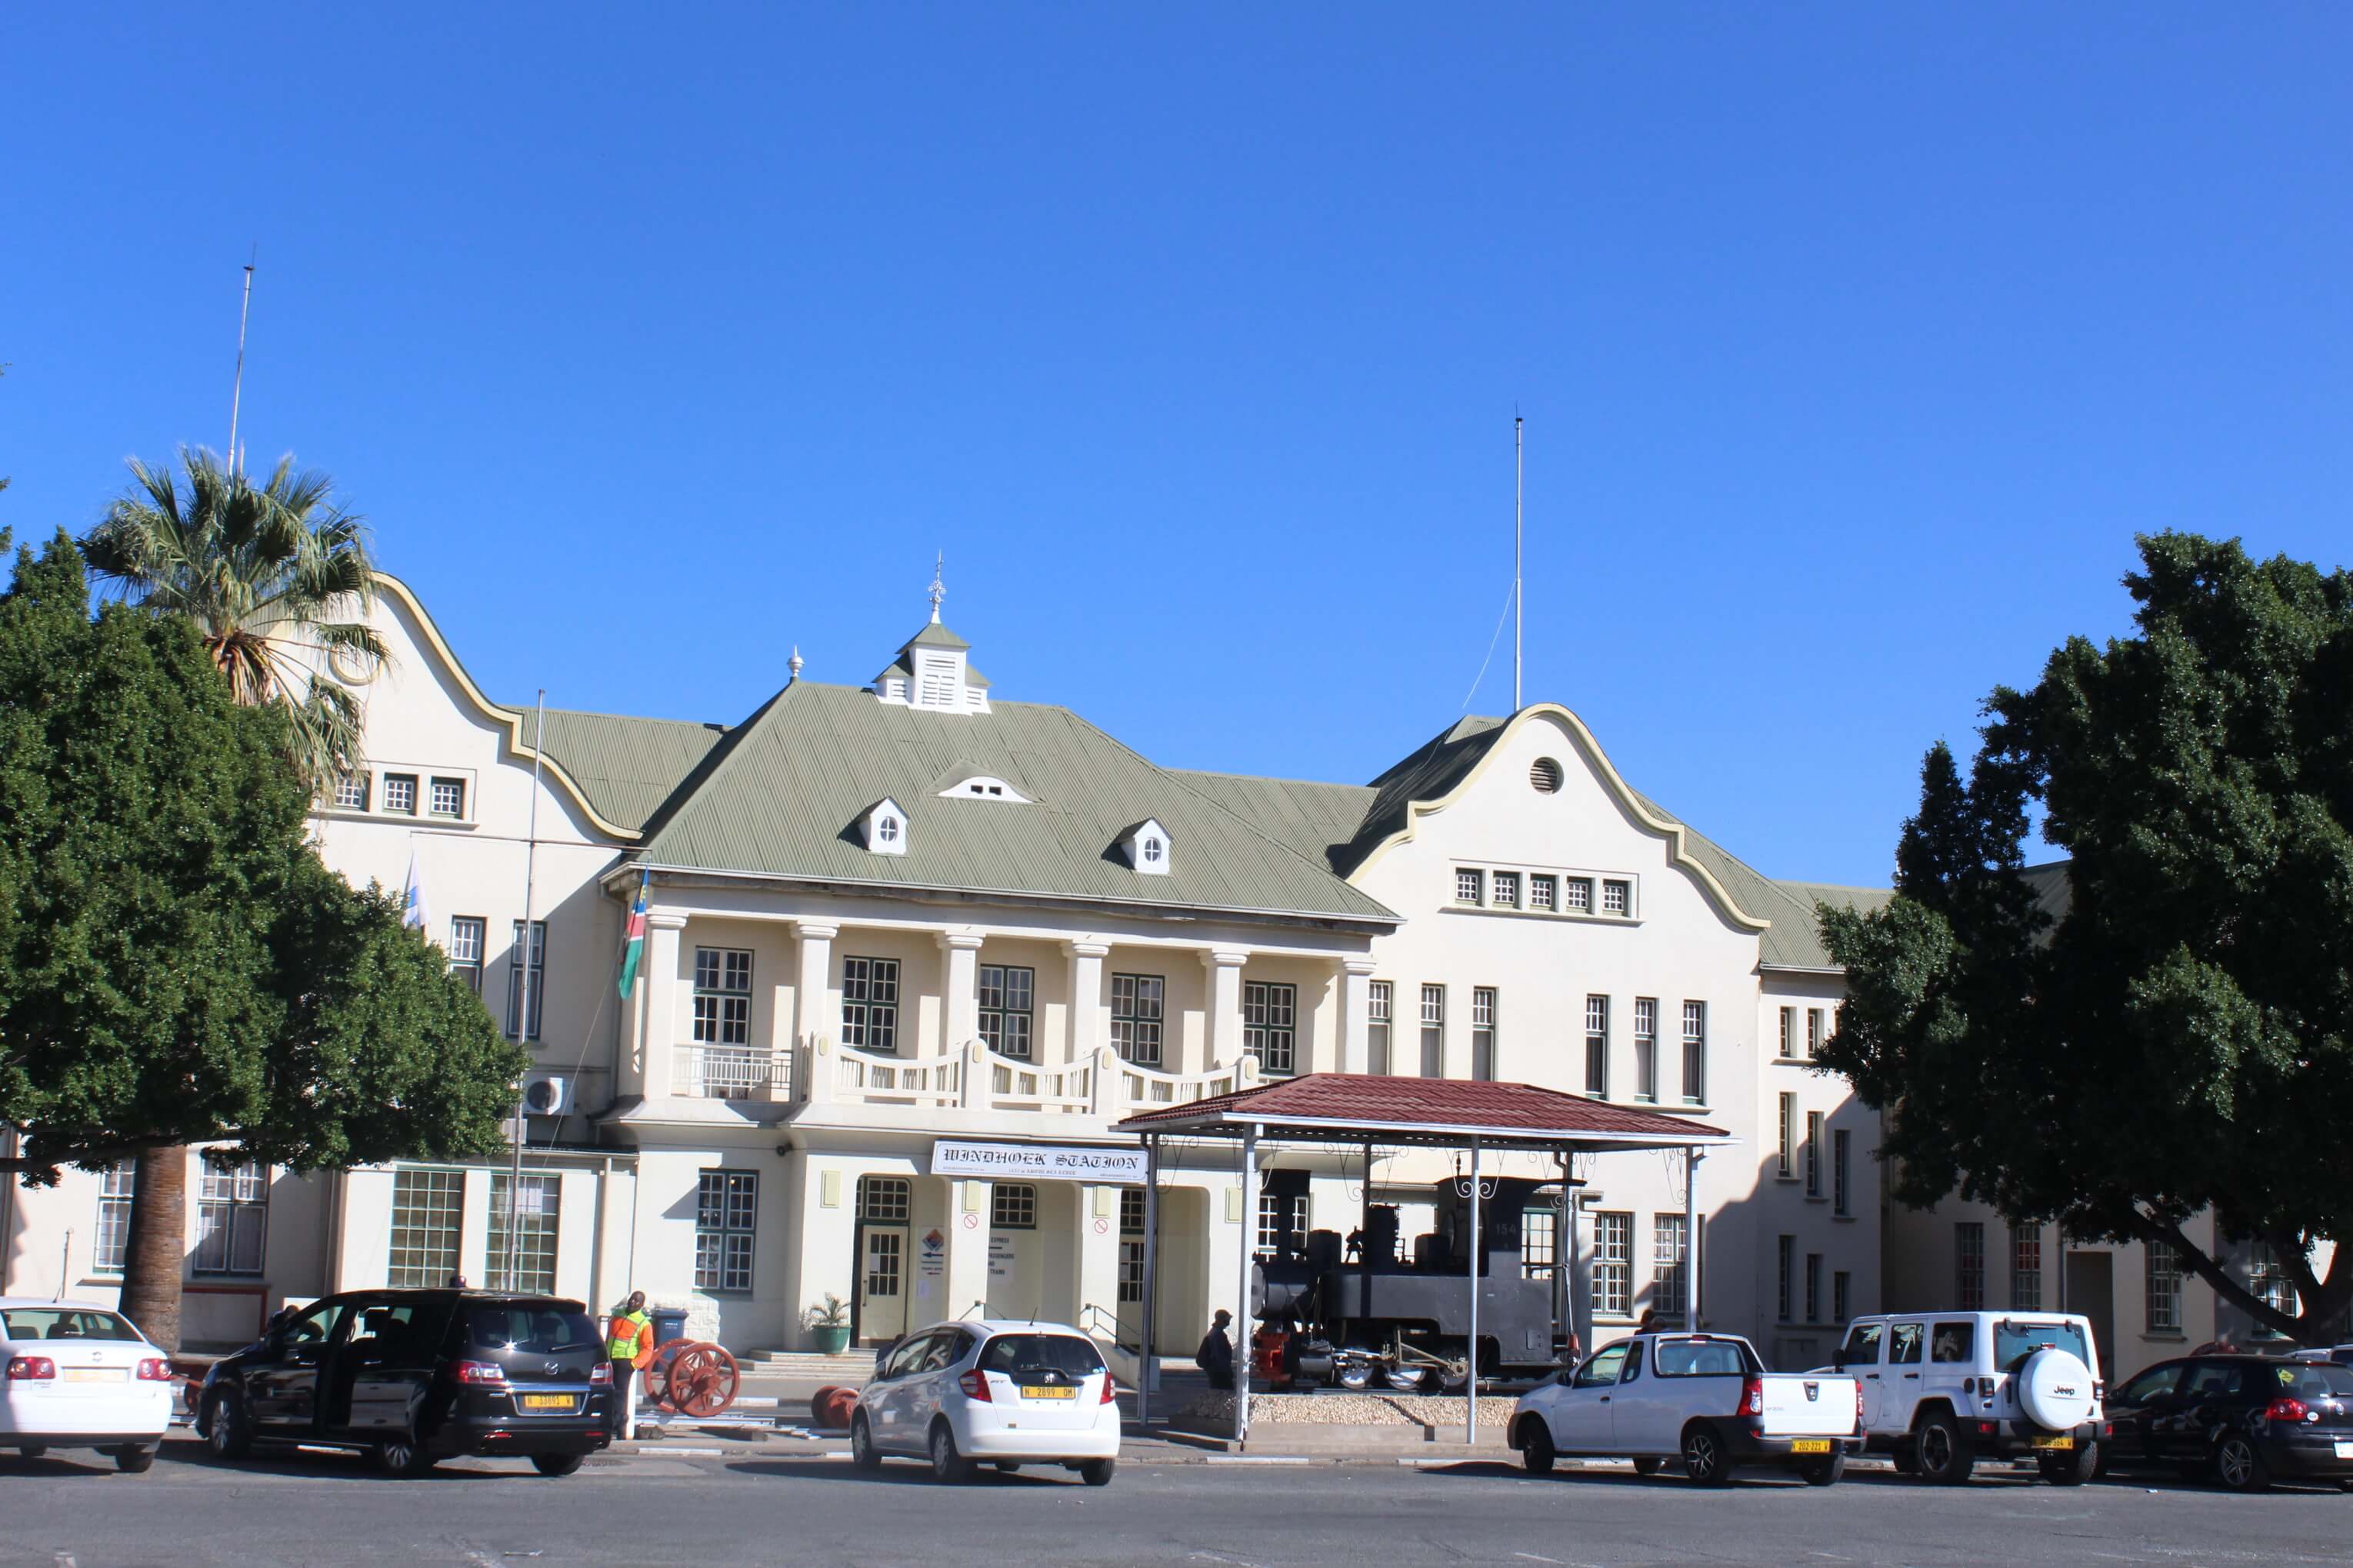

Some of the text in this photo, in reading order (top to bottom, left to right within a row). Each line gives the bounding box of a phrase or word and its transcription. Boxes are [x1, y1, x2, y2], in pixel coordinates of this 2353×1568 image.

[945, 1149, 1138, 1169] WINDHOEK STATION
[1496, 1224, 1515, 1235] 154
[1025, 1387, 1029, 1397] N
[1037, 1387, 1055, 1397] 2899
[2054, 1385, 2075, 1397] Jeep
